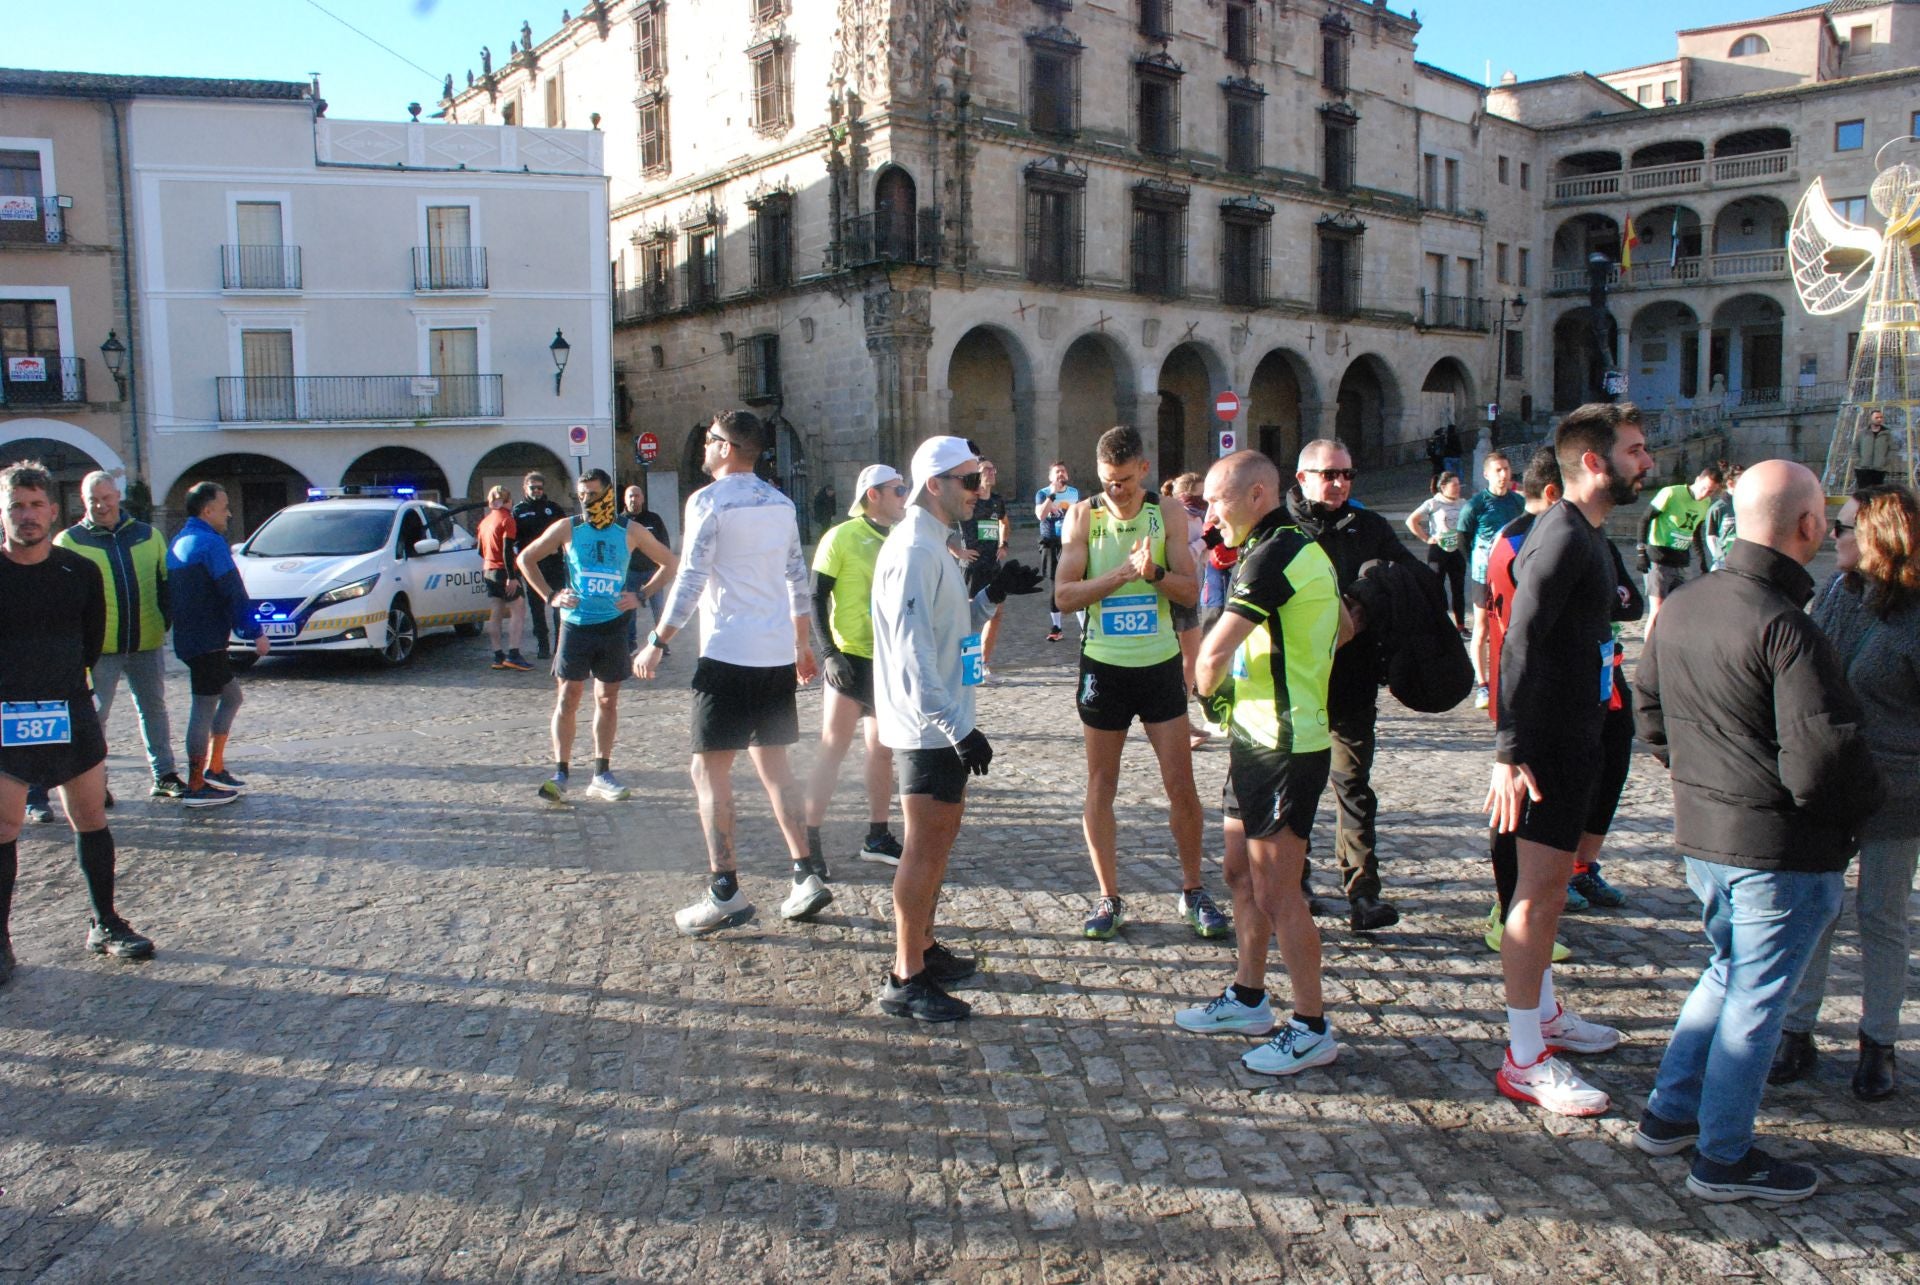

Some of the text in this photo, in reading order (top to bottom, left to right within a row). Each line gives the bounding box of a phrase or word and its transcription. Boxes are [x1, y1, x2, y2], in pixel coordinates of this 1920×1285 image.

[445, 571, 486, 587] POLICI
[587, 578, 615, 595] 504
[471, 584, 489, 595] LOC
[1113, 612, 1149, 632] 582
[16, 718, 57, 739] 587
